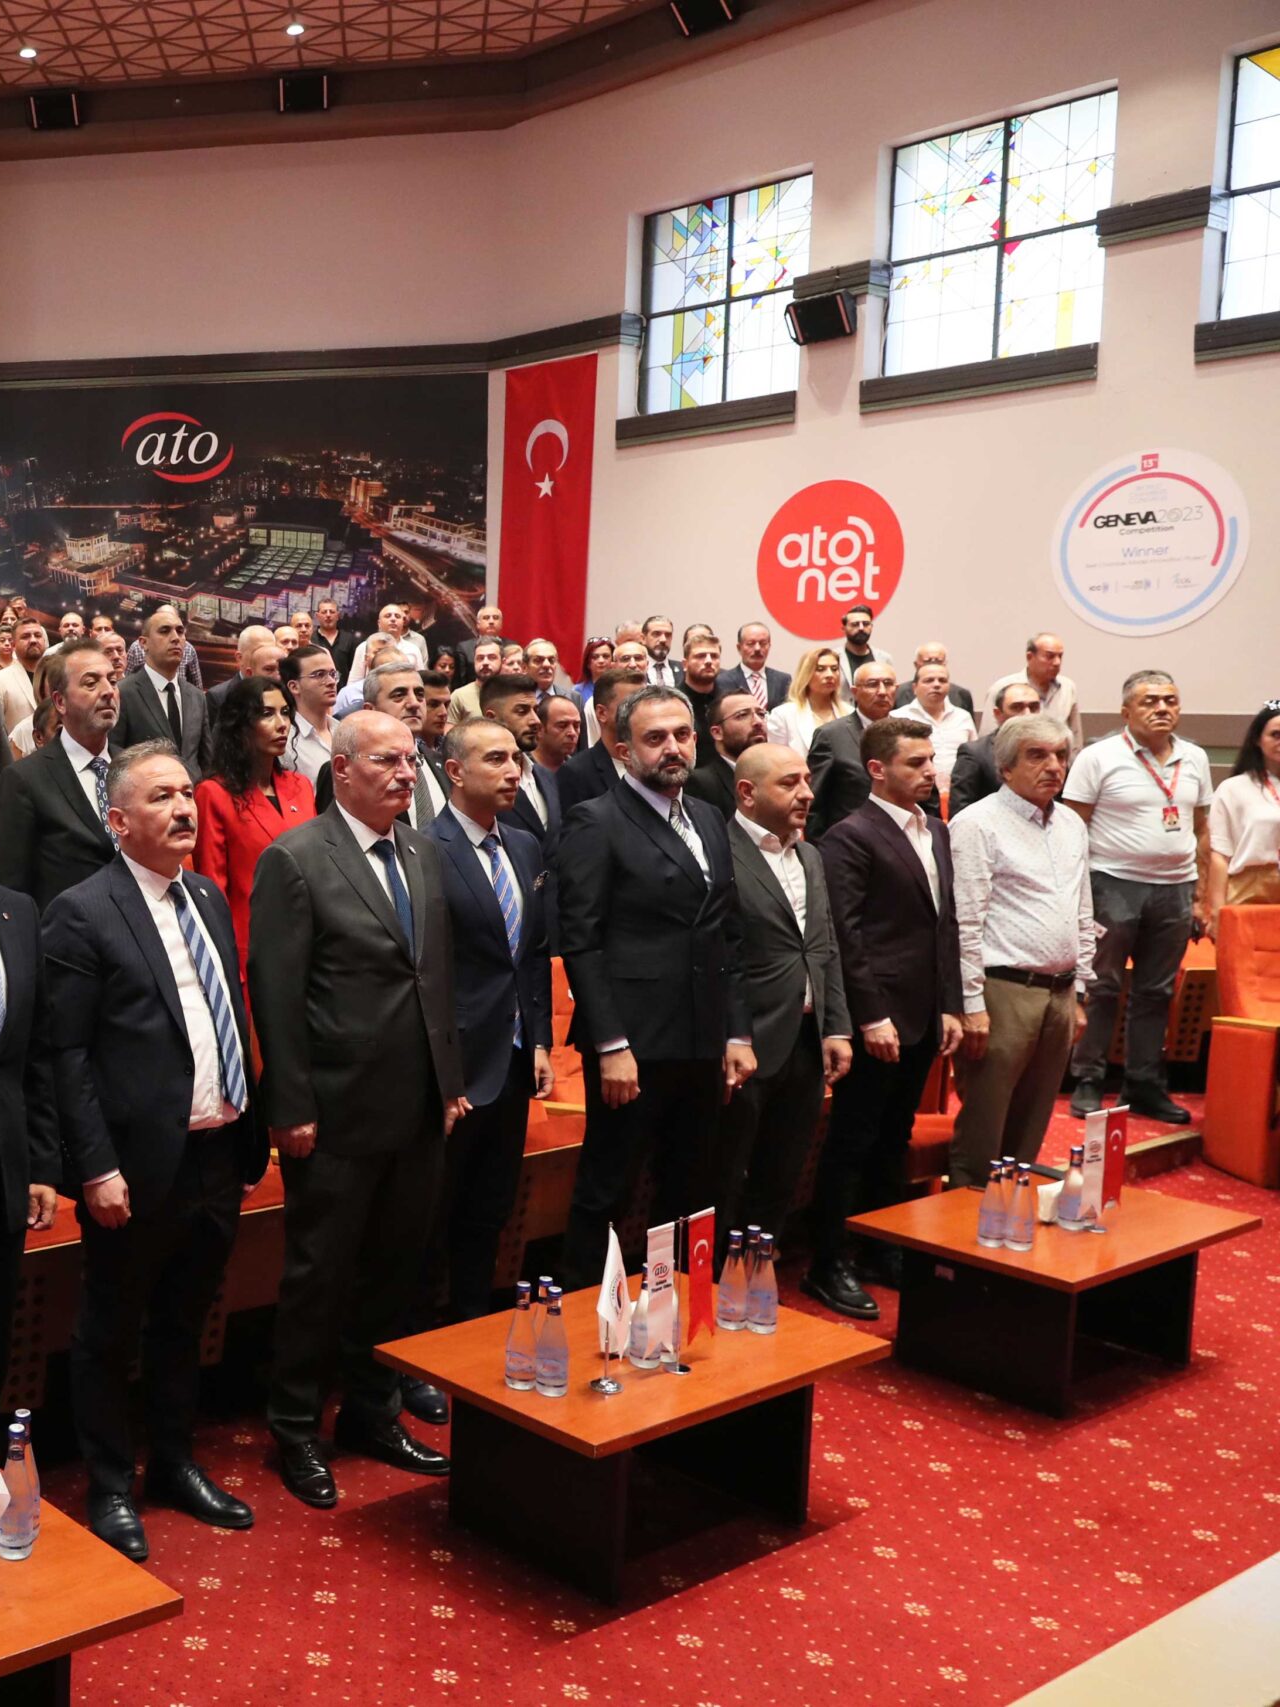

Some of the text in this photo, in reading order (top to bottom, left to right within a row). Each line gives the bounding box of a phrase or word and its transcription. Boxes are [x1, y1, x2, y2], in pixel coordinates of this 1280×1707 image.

[136, 423, 219, 466] ato
[776, 525, 862, 568] ato
[1119, 525, 1175, 536] Competition
[1121, 546, 1170, 558] Winner
[796, 552, 881, 602] net
